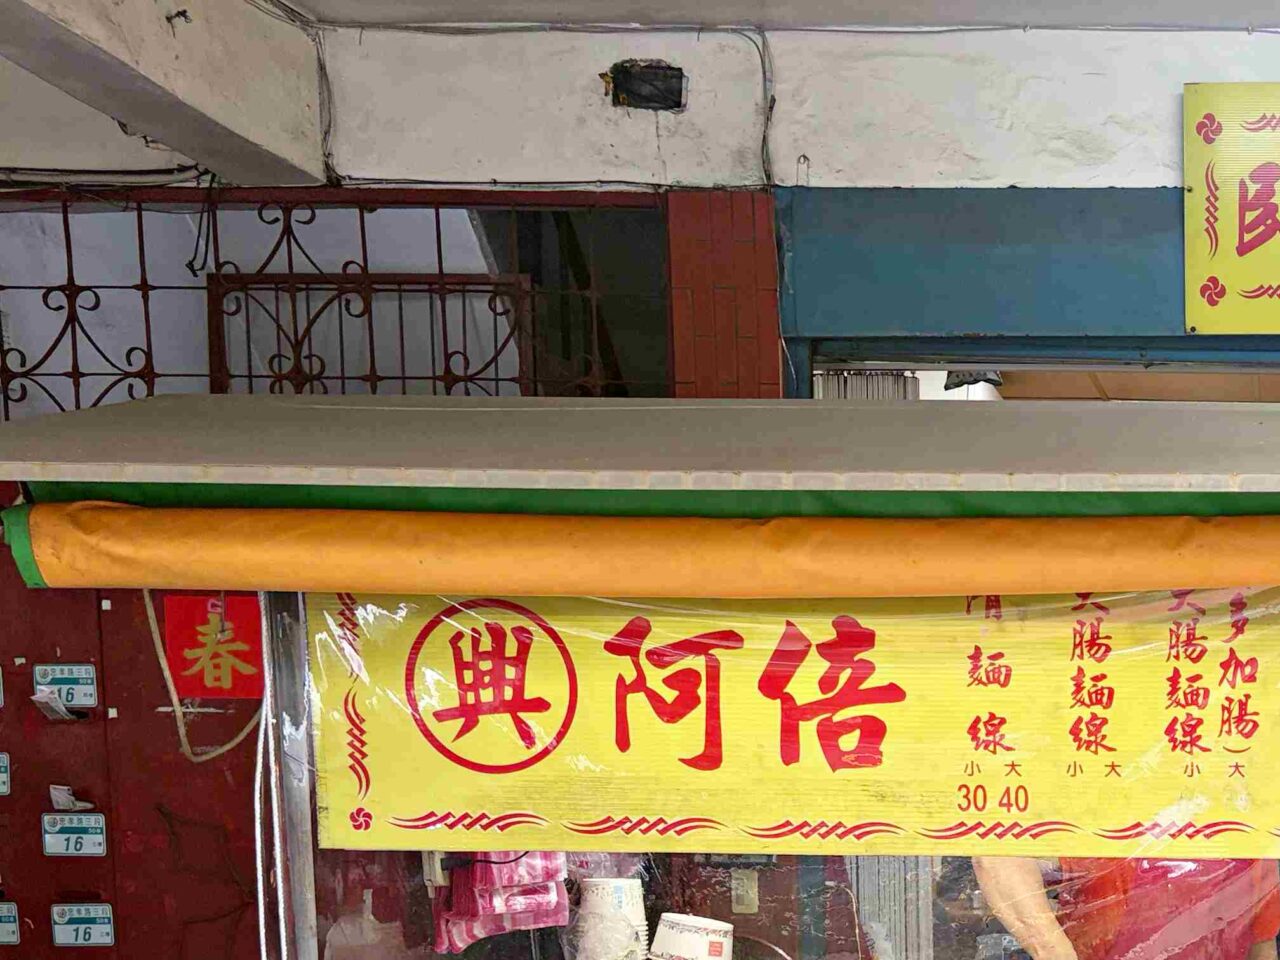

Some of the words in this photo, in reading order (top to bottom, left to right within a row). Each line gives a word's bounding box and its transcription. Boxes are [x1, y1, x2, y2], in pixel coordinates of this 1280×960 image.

[180, 611, 258, 689] 春
[433, 621, 551, 750] 興
[603, 615, 907, 772] 阿倍
[963, 760, 982, 778] 小
[1004, 760, 1023, 778] 大
[1066, 760, 1084, 778] 小
[1104, 760, 1122, 778] 大
[1183, 761, 1201, 778] 小
[1228, 761, 1246, 778] 大
[957, 783, 987, 812] 30
[998, 784, 1029, 813] 40
[64, 835, 84, 852] 16
[73, 926, 92, 942] 16
